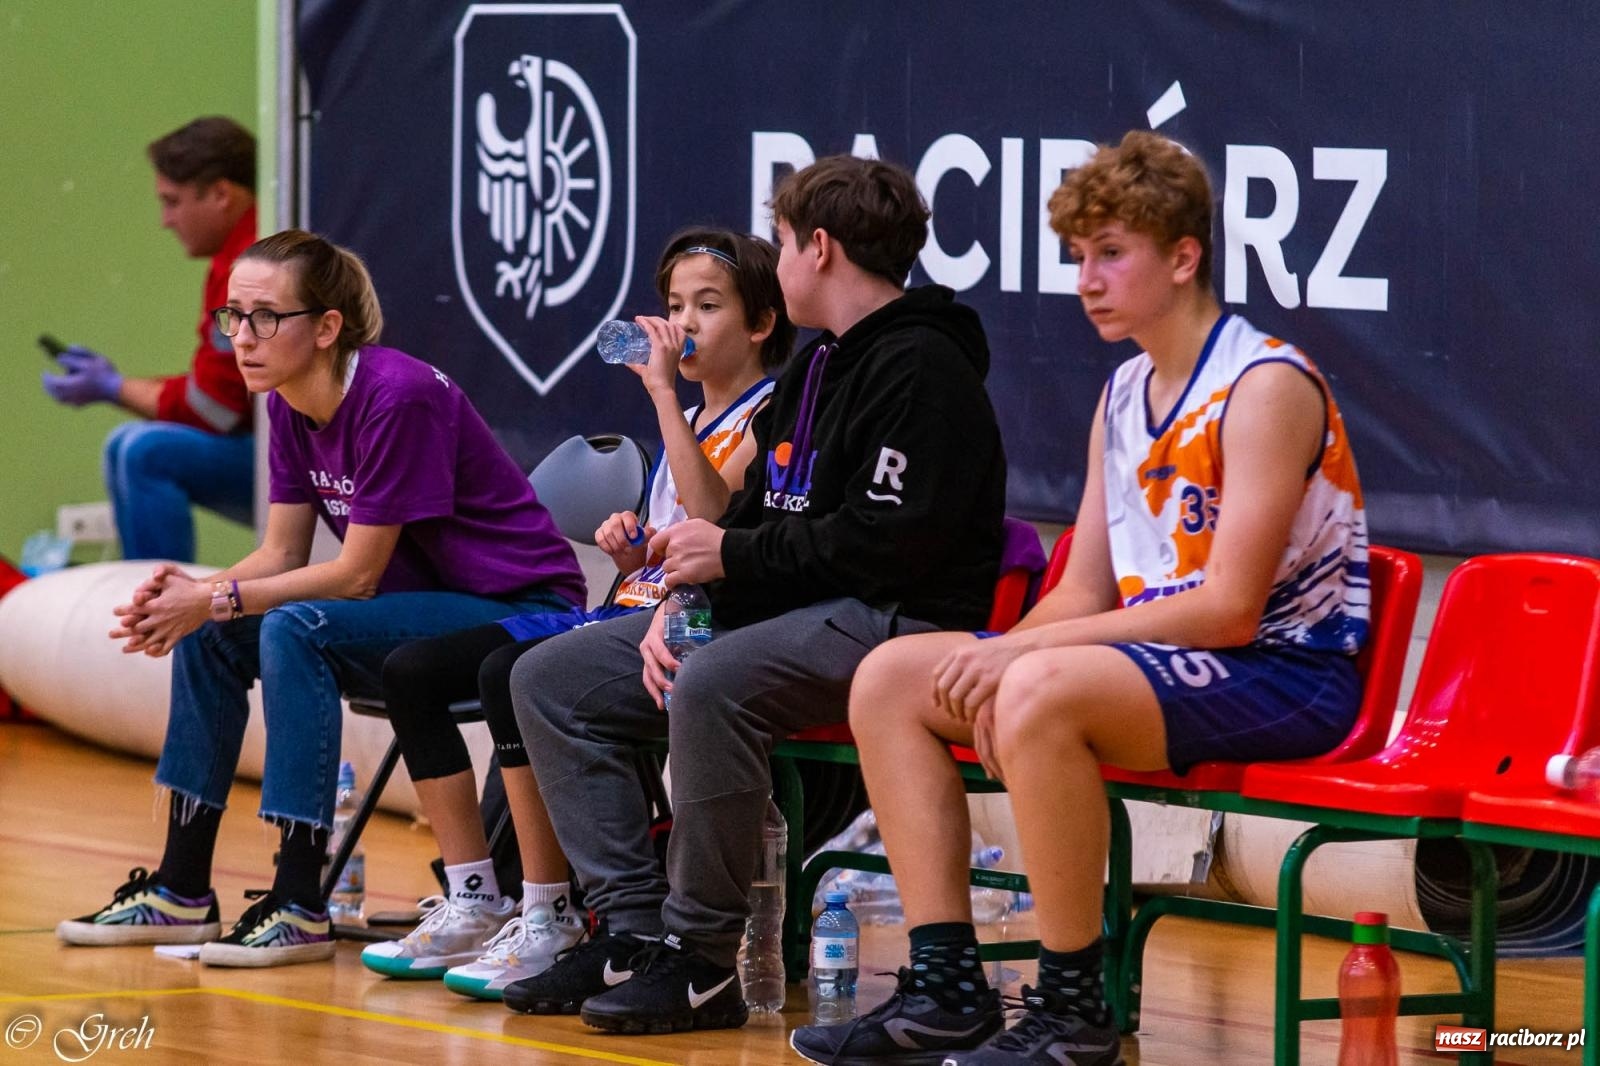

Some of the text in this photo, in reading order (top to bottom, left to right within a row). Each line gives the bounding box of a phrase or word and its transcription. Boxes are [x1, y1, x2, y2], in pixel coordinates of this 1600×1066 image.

[752, 80, 1389, 311] CIBRZ
[872, 446, 908, 491] R
[456, 891, 495, 902] LOTTO
